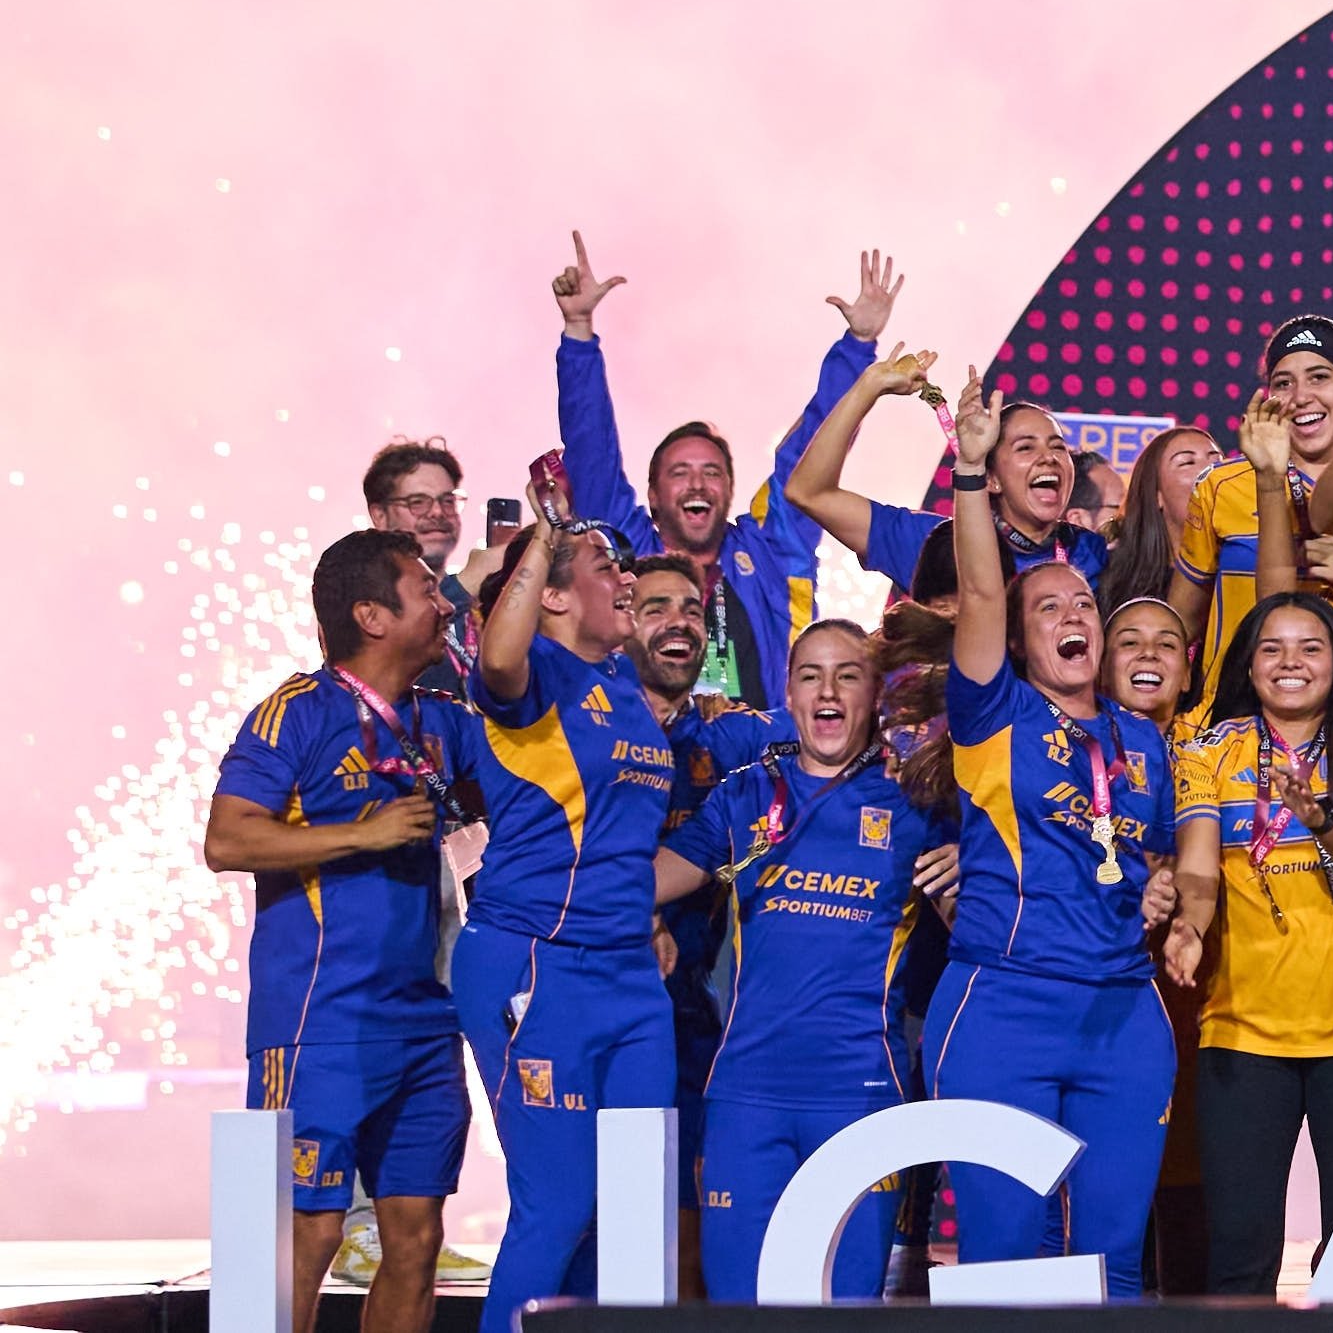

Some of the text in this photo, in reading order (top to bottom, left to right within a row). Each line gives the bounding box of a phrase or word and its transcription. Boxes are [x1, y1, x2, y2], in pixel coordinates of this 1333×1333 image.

[1286, 338, 1322, 348] adidas
[1260, 767, 1269, 788] LIGA
[1274, 806, 1293, 831] LIGA
[784, 869, 881, 900] CEMEX
[758, 895, 874, 924] SPORTIUMBET
